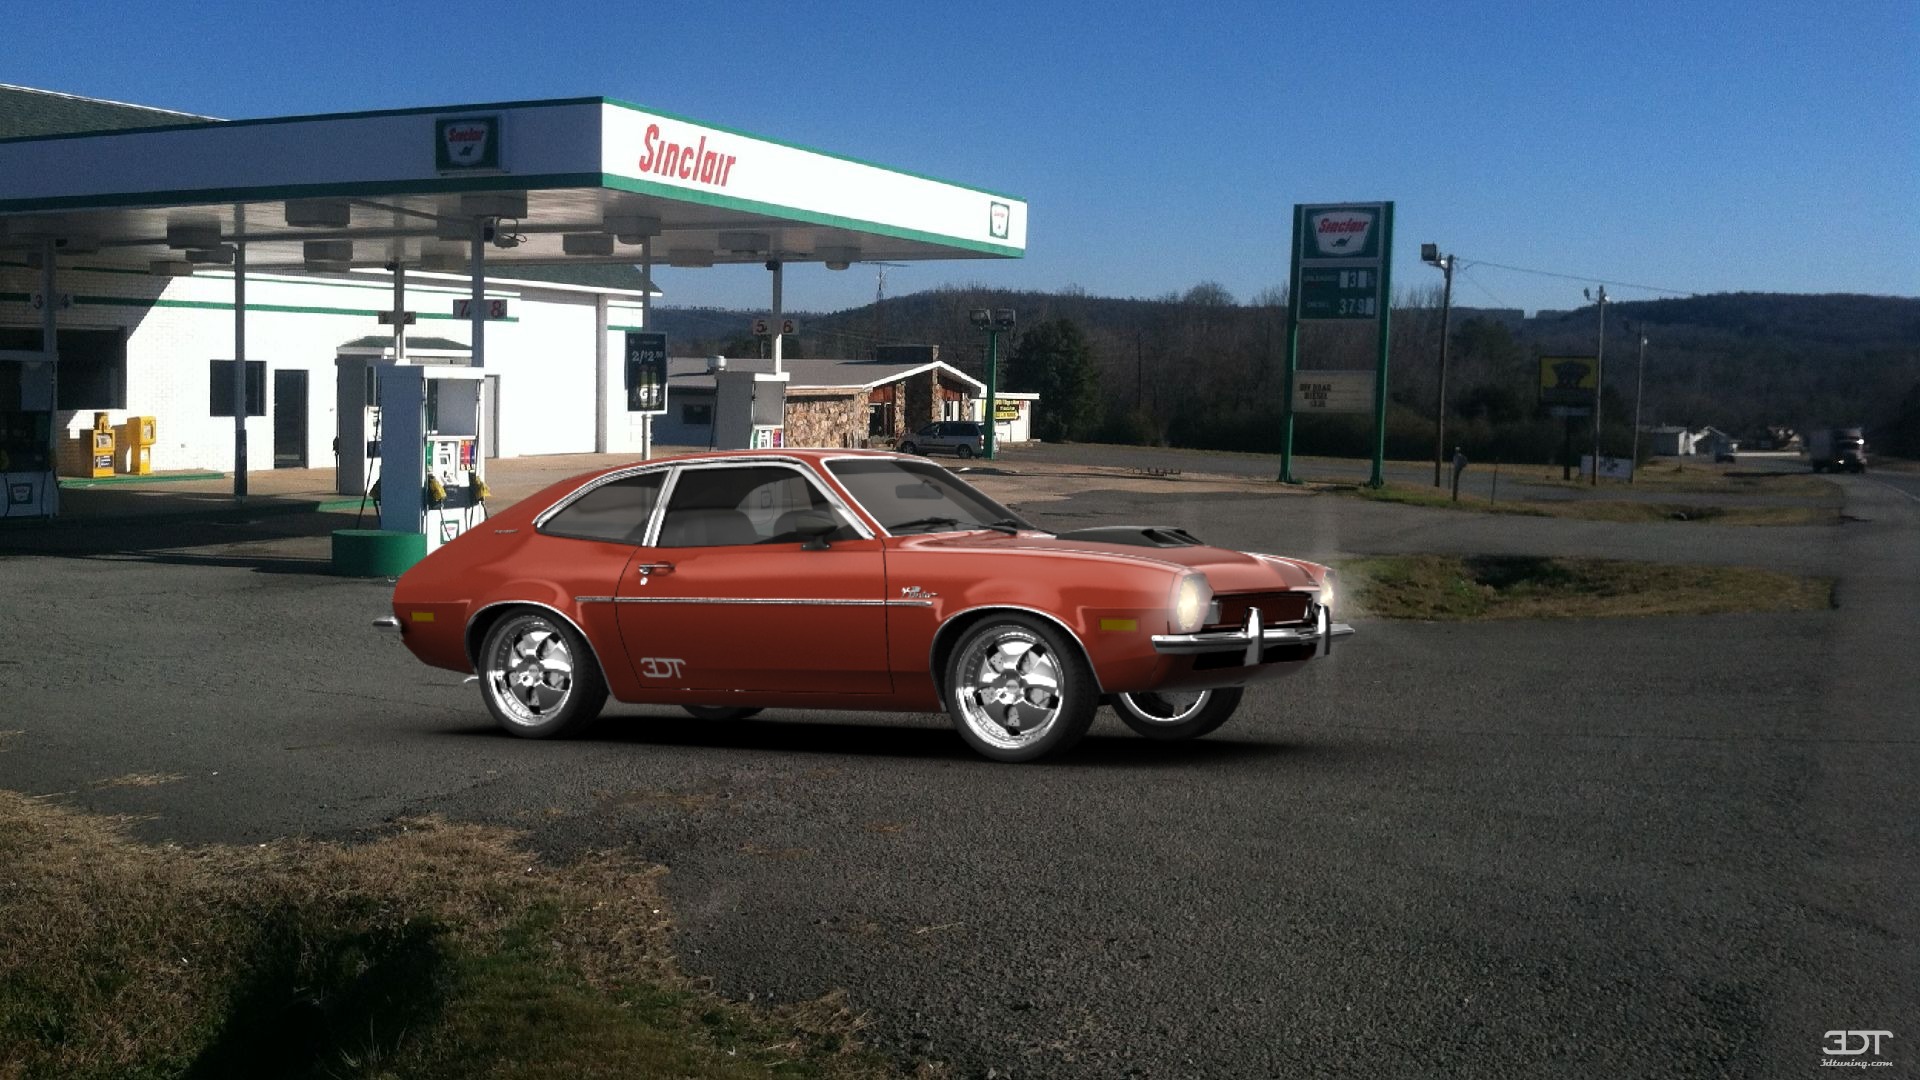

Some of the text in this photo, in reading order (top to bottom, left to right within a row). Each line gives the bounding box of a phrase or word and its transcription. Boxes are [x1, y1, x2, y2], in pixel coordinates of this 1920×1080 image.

[639, 123, 737, 187] Sinclair
[1318, 217, 1369, 234] Sinclair
[491, 300, 504, 318] 8
[756, 320, 767, 333] 5
[783, 319, 793, 333] 6
